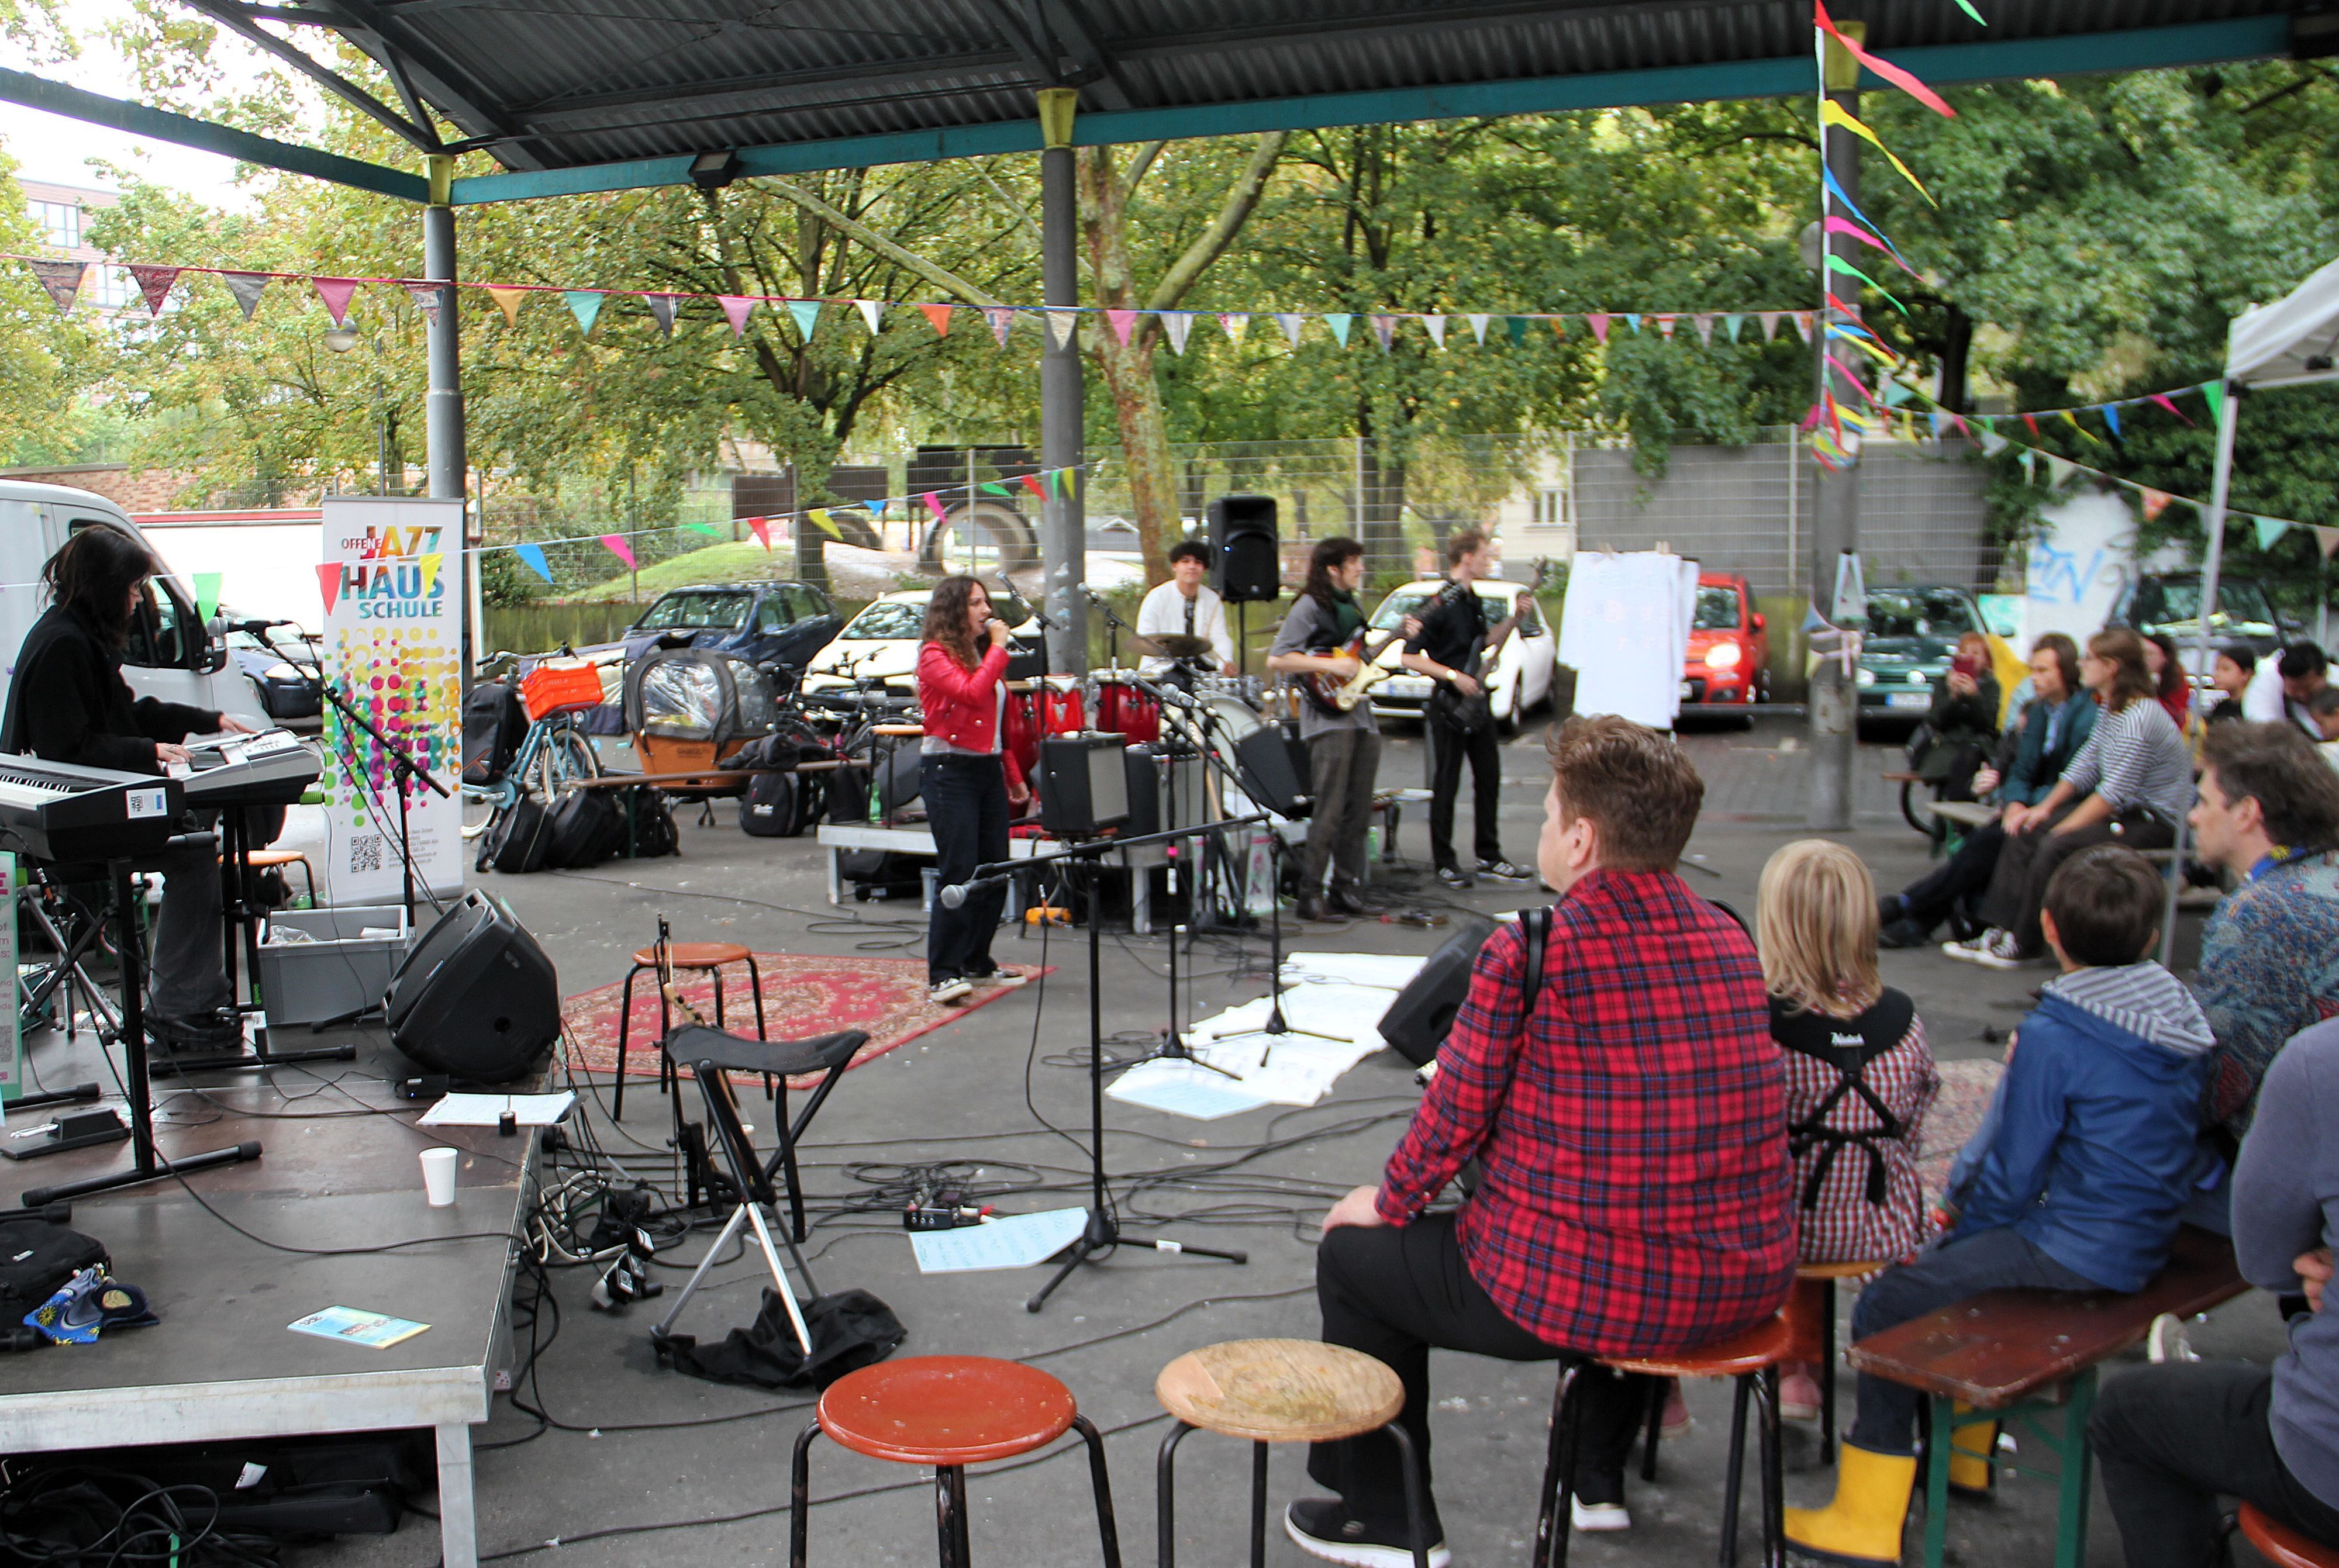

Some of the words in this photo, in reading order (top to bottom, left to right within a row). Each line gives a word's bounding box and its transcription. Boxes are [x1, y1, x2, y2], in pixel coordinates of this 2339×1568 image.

[341, 537, 382, 550] OFFENE
[360, 524, 444, 562] JAZZ
[341, 564, 446, 600] HAUS
[359, 600, 444, 619] SCHULE
